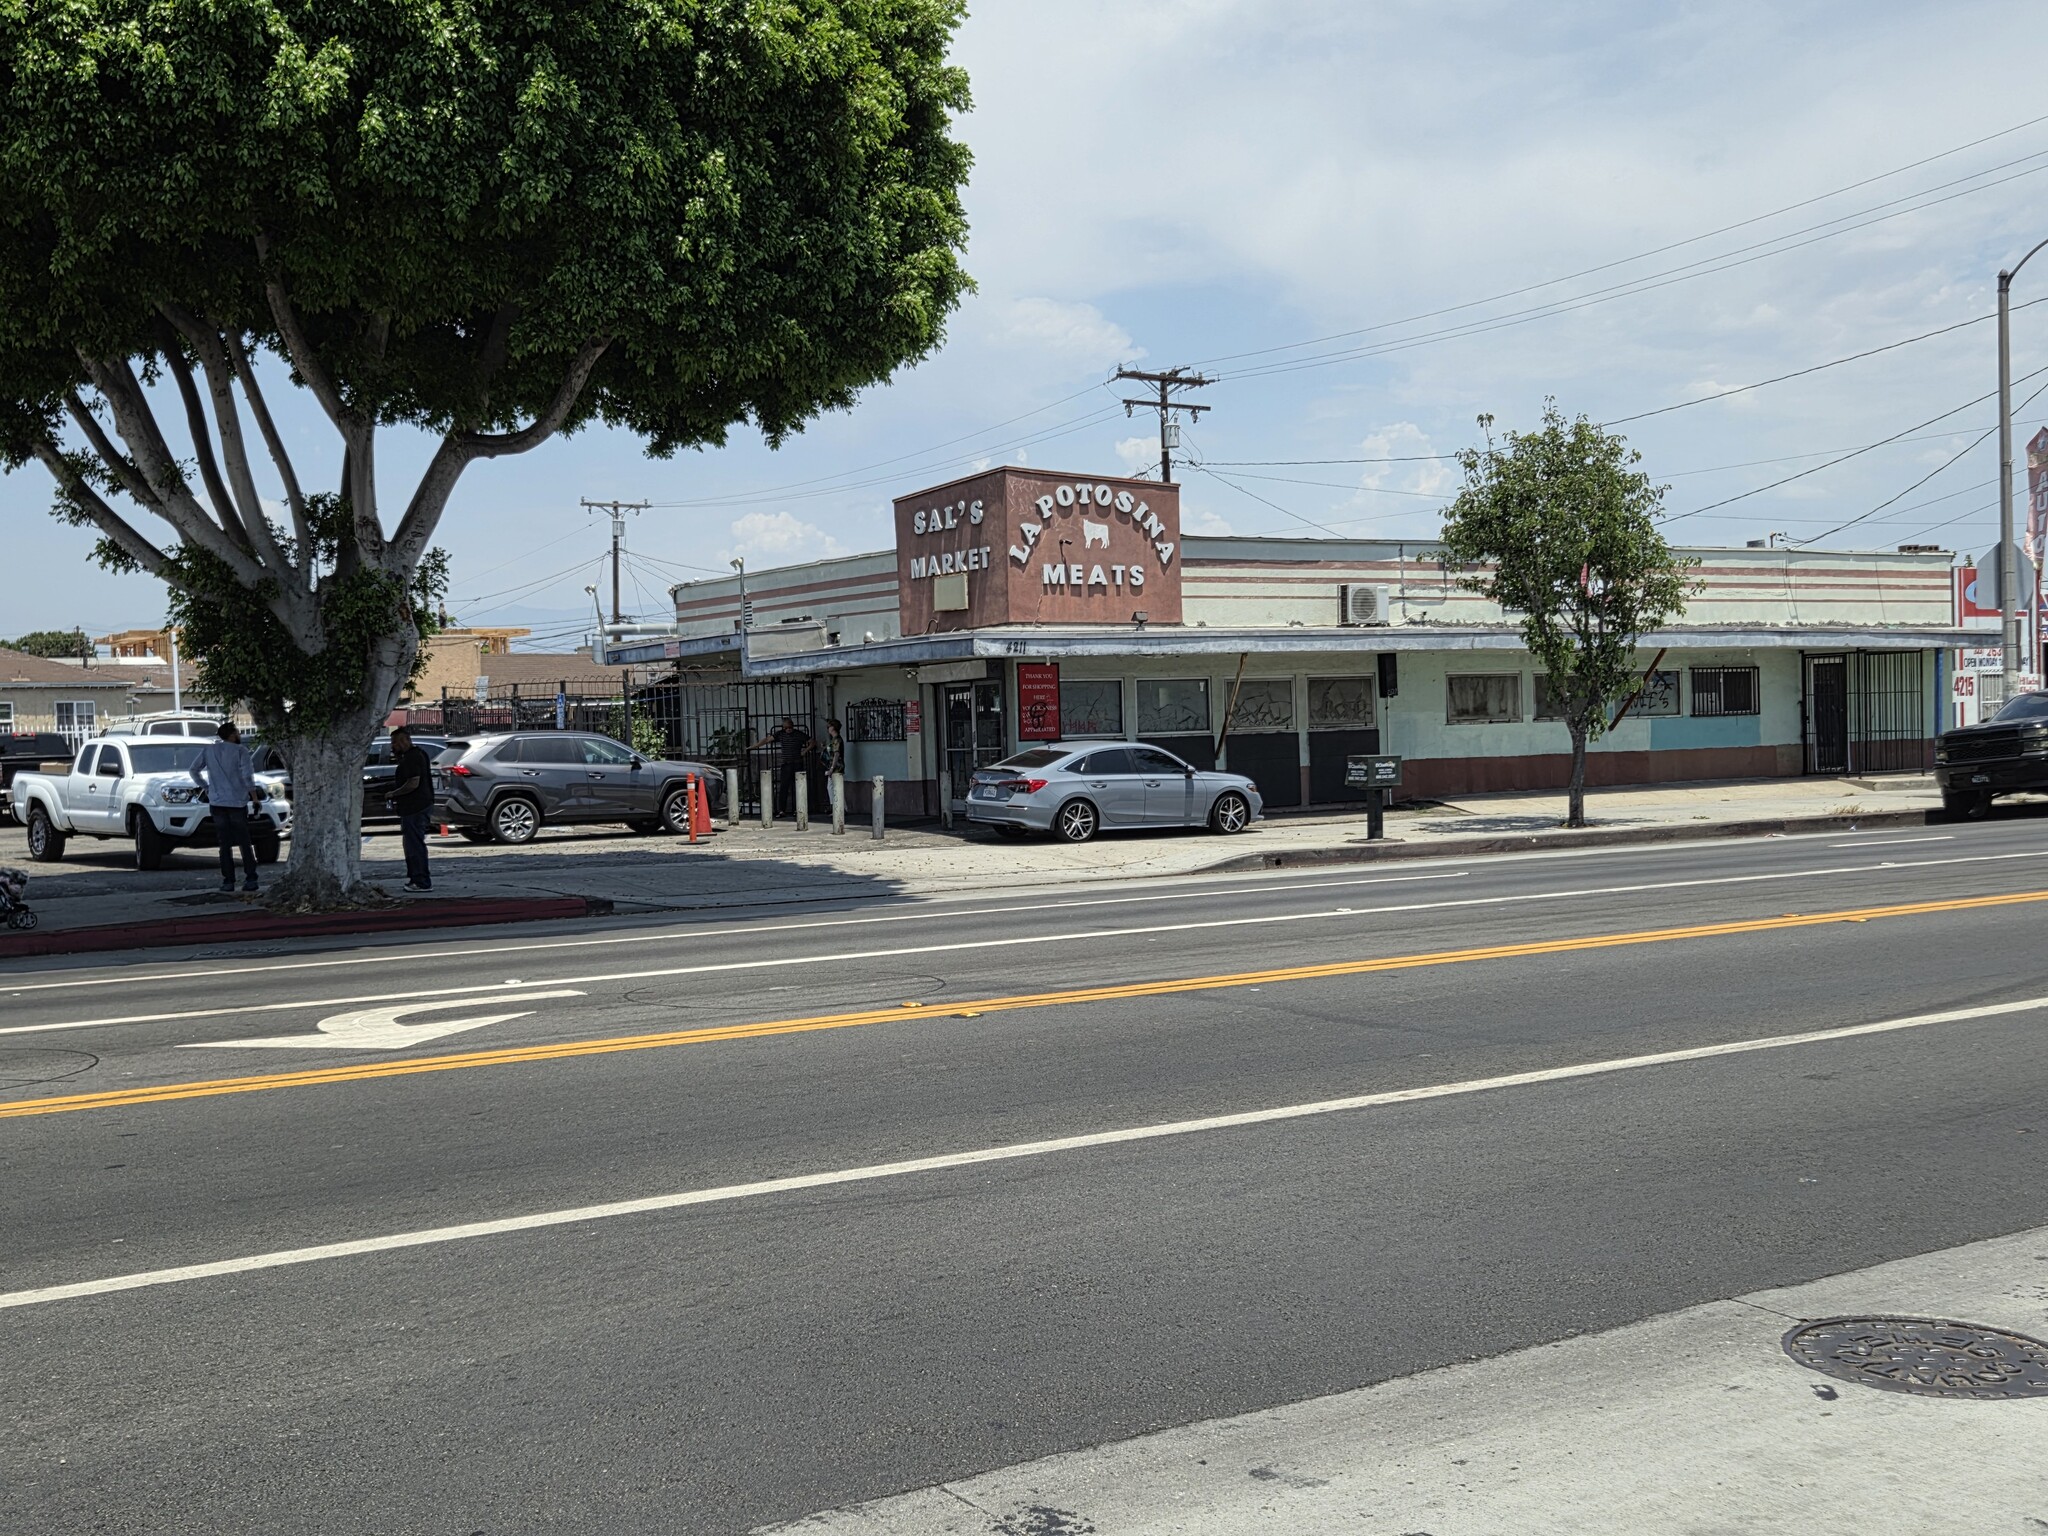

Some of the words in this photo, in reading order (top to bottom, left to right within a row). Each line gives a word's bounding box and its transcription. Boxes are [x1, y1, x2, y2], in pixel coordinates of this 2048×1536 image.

[914, 500, 983, 535] SAL'S
[1009, 522, 1041, 564] LA
[1035, 483, 1174, 564] POTOSINA
[910, 546, 990, 579] MARKET
[1043, 563, 1144, 586] MEATS
[1005, 641, 1026, 655] 4211
[1953, 676, 1974, 696] 4215
